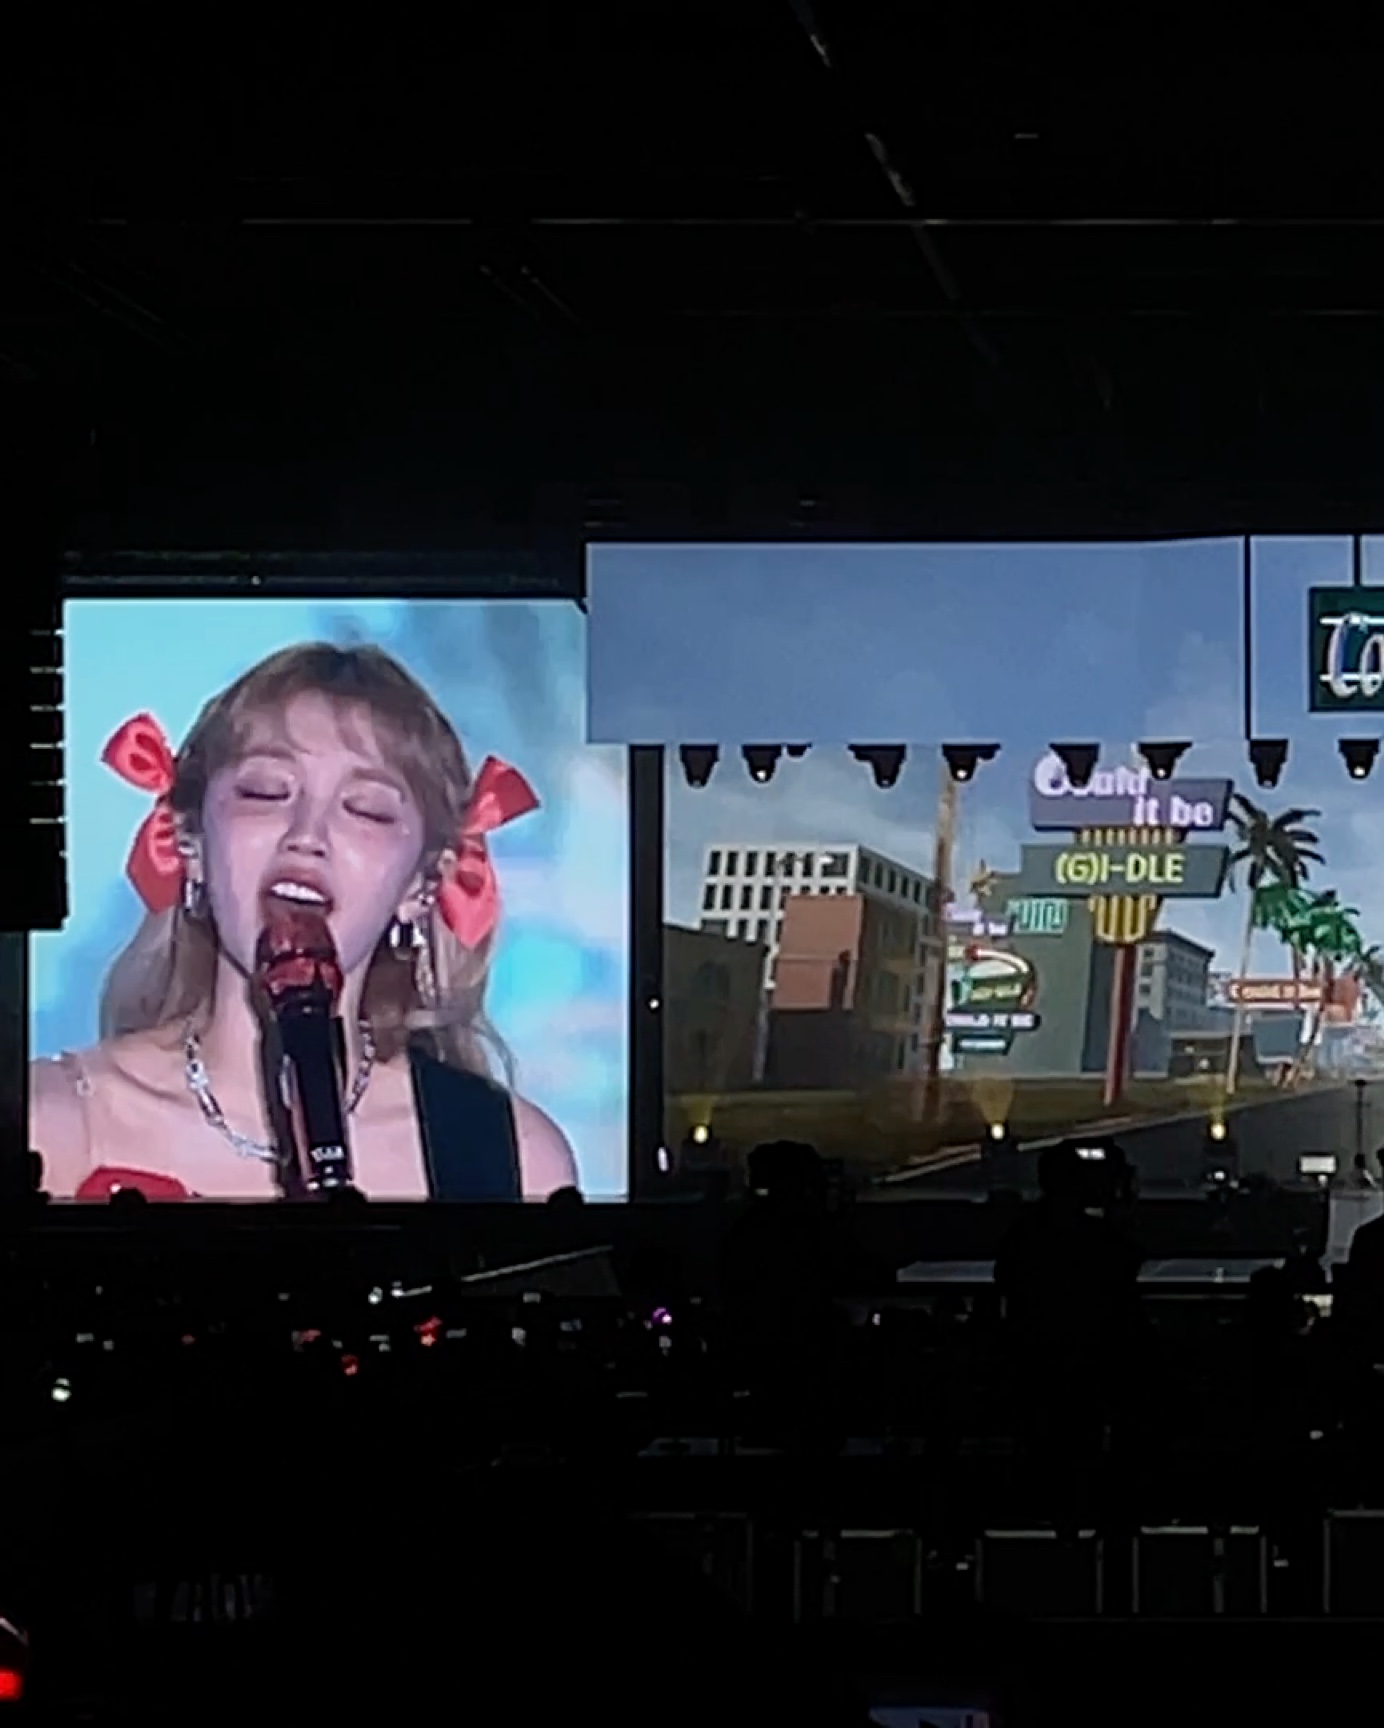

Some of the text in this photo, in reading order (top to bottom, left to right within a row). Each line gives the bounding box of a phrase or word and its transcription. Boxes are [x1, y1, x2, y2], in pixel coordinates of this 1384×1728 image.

[1034, 745, 1151, 796] Culd
[1133, 795, 1213, 826] it be
[1055, 853, 1186, 885] (G)I-DLE
